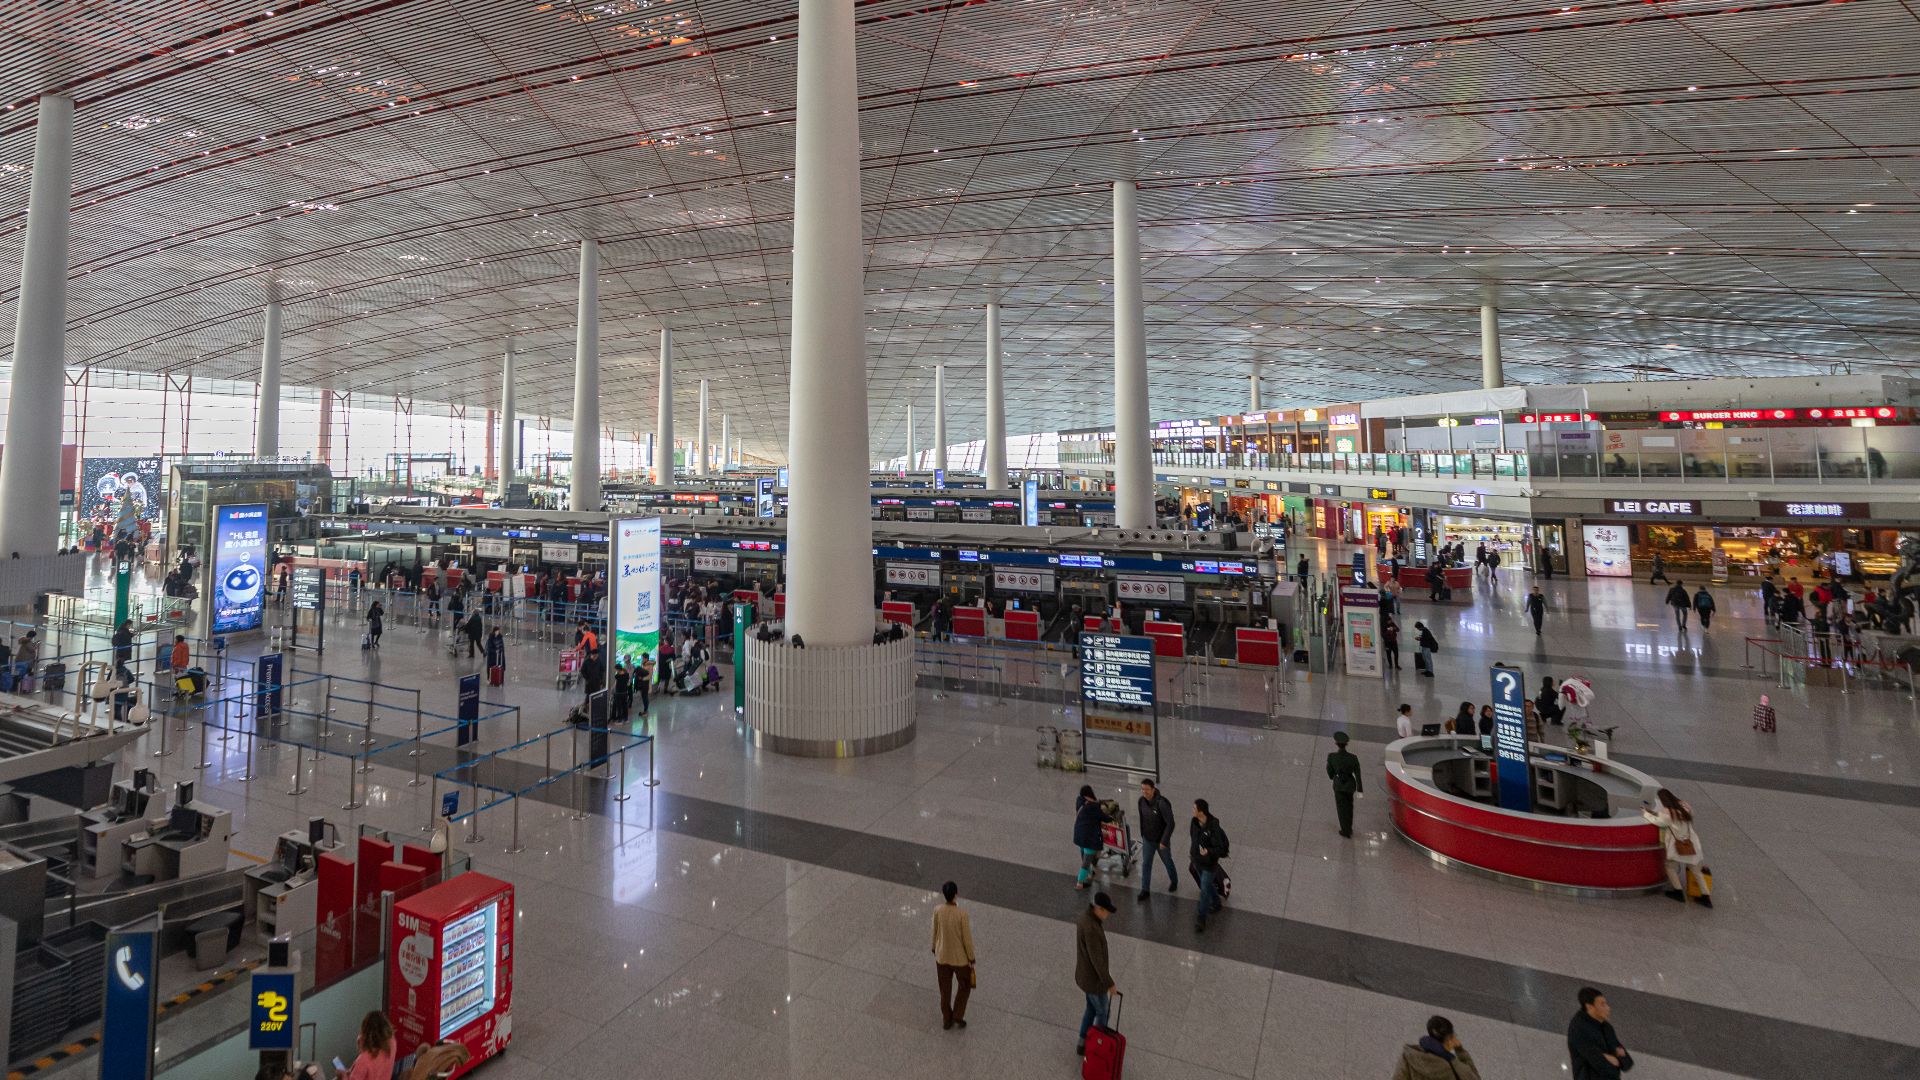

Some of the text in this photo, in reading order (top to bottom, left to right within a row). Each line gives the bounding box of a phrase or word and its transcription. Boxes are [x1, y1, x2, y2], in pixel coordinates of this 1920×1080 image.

[1693, 410, 1759, 419] BURGER KING
[1834, 409, 1867, 417] 汉堡王
[1614, 501, 1692, 514] LEI CAFE
[1499, 750, 1525, 762] 96158
[397, 911, 420, 932] SIM
[260, 1021, 284, 1032] 220V
